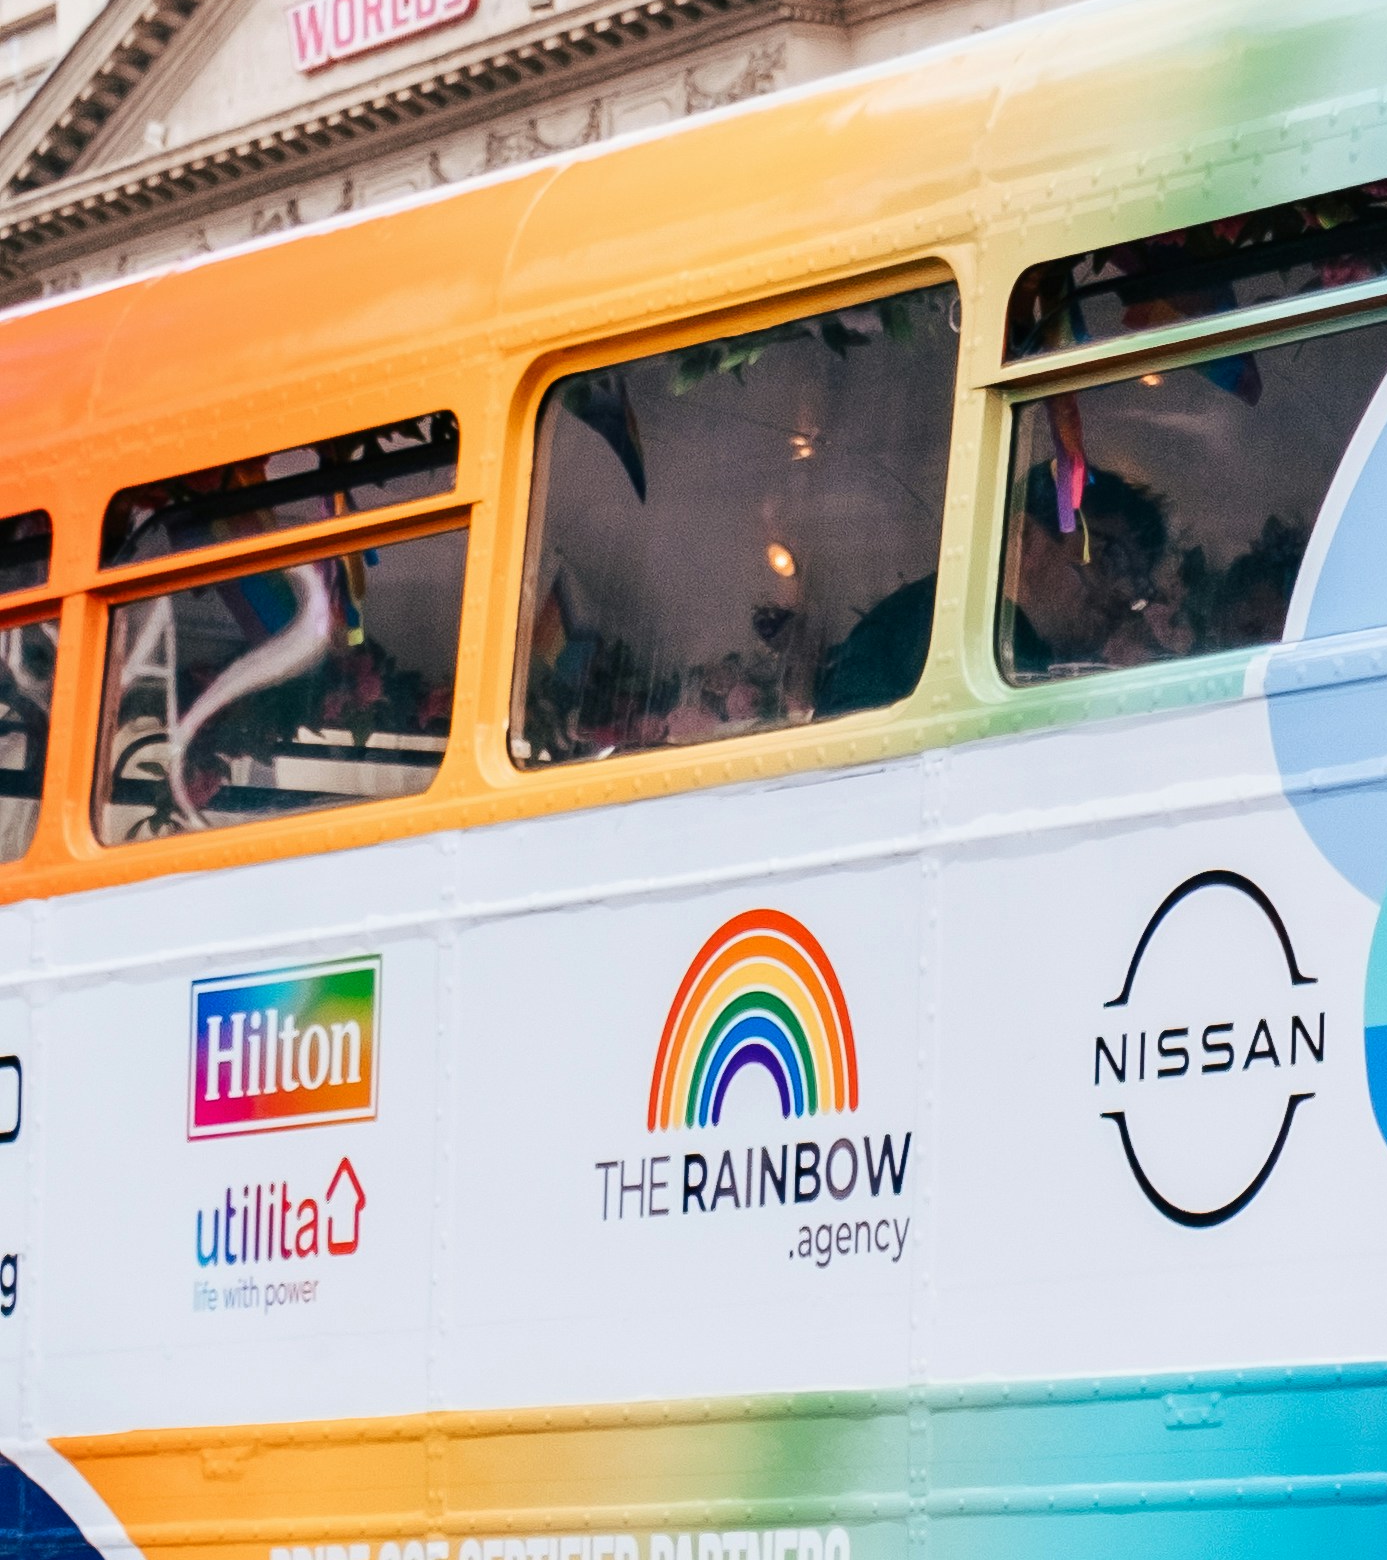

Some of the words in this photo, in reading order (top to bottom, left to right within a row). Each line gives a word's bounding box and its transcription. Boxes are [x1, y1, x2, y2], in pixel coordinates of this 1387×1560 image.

[204, 1007, 362, 1101] Hilton
[1093, 1010, 1326, 1087] NISSAN
[594, 1154, 671, 1221] THE
[682, 1131, 913, 1215] RAINBOW
[195, 1180, 319, 1269] utilita
[788, 1216, 911, 1269] .agency
[193, 1279, 218, 1313] life
[222, 1276, 260, 1310] with
[263, 1279, 320, 1316] power
